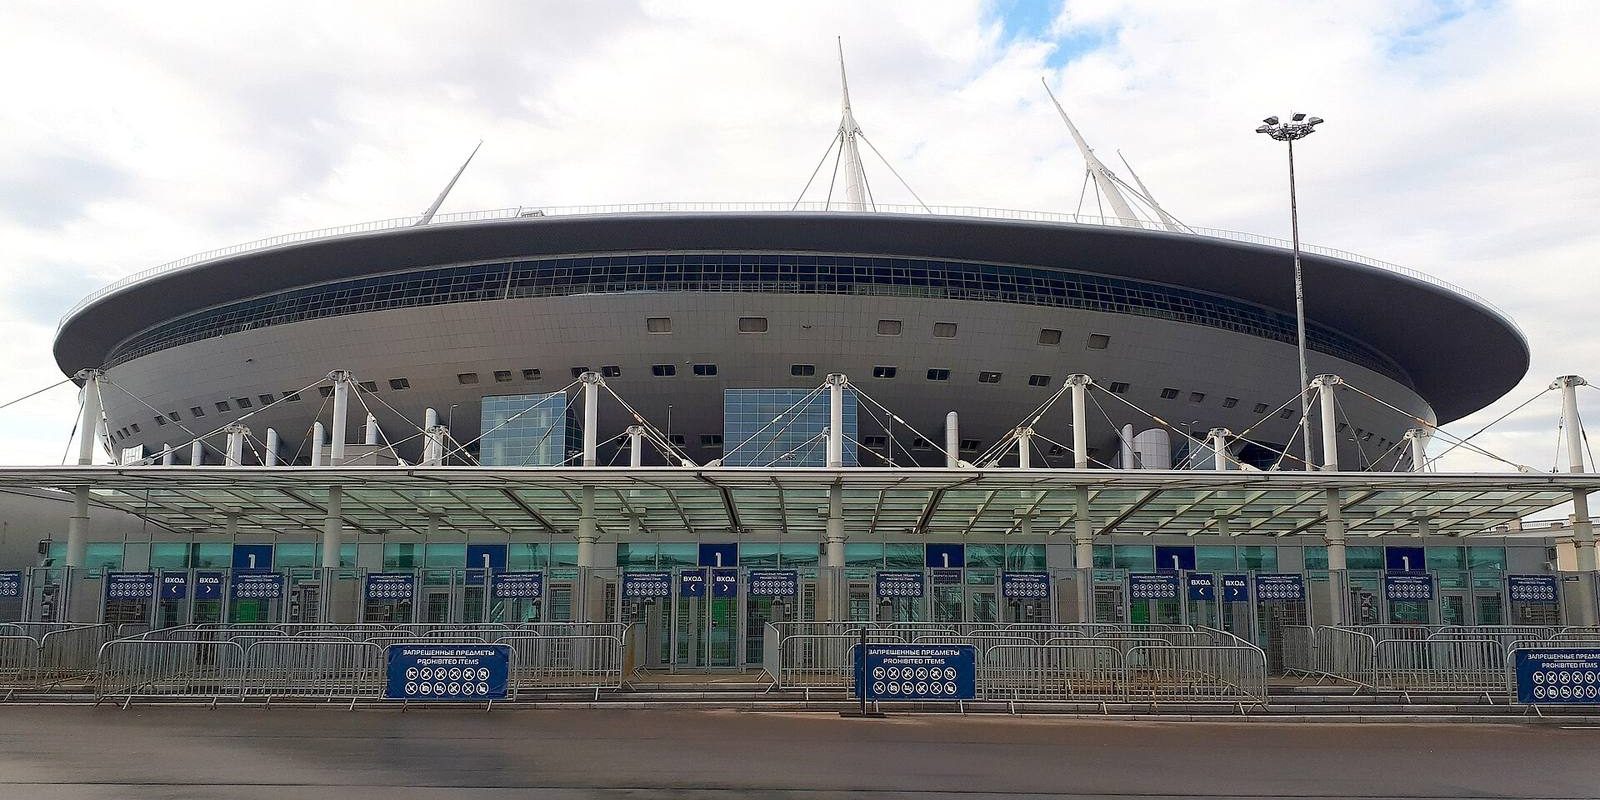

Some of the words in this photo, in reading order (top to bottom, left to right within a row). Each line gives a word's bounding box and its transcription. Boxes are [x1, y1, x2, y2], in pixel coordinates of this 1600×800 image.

[249, 554, 255, 568] 1
[483, 554, 489, 568] 1
[716, 552, 722, 567] 1
[942, 553, 948, 567] 1
[1172, 555, 1178, 570] 1
[1402, 556, 1408, 571] 1
